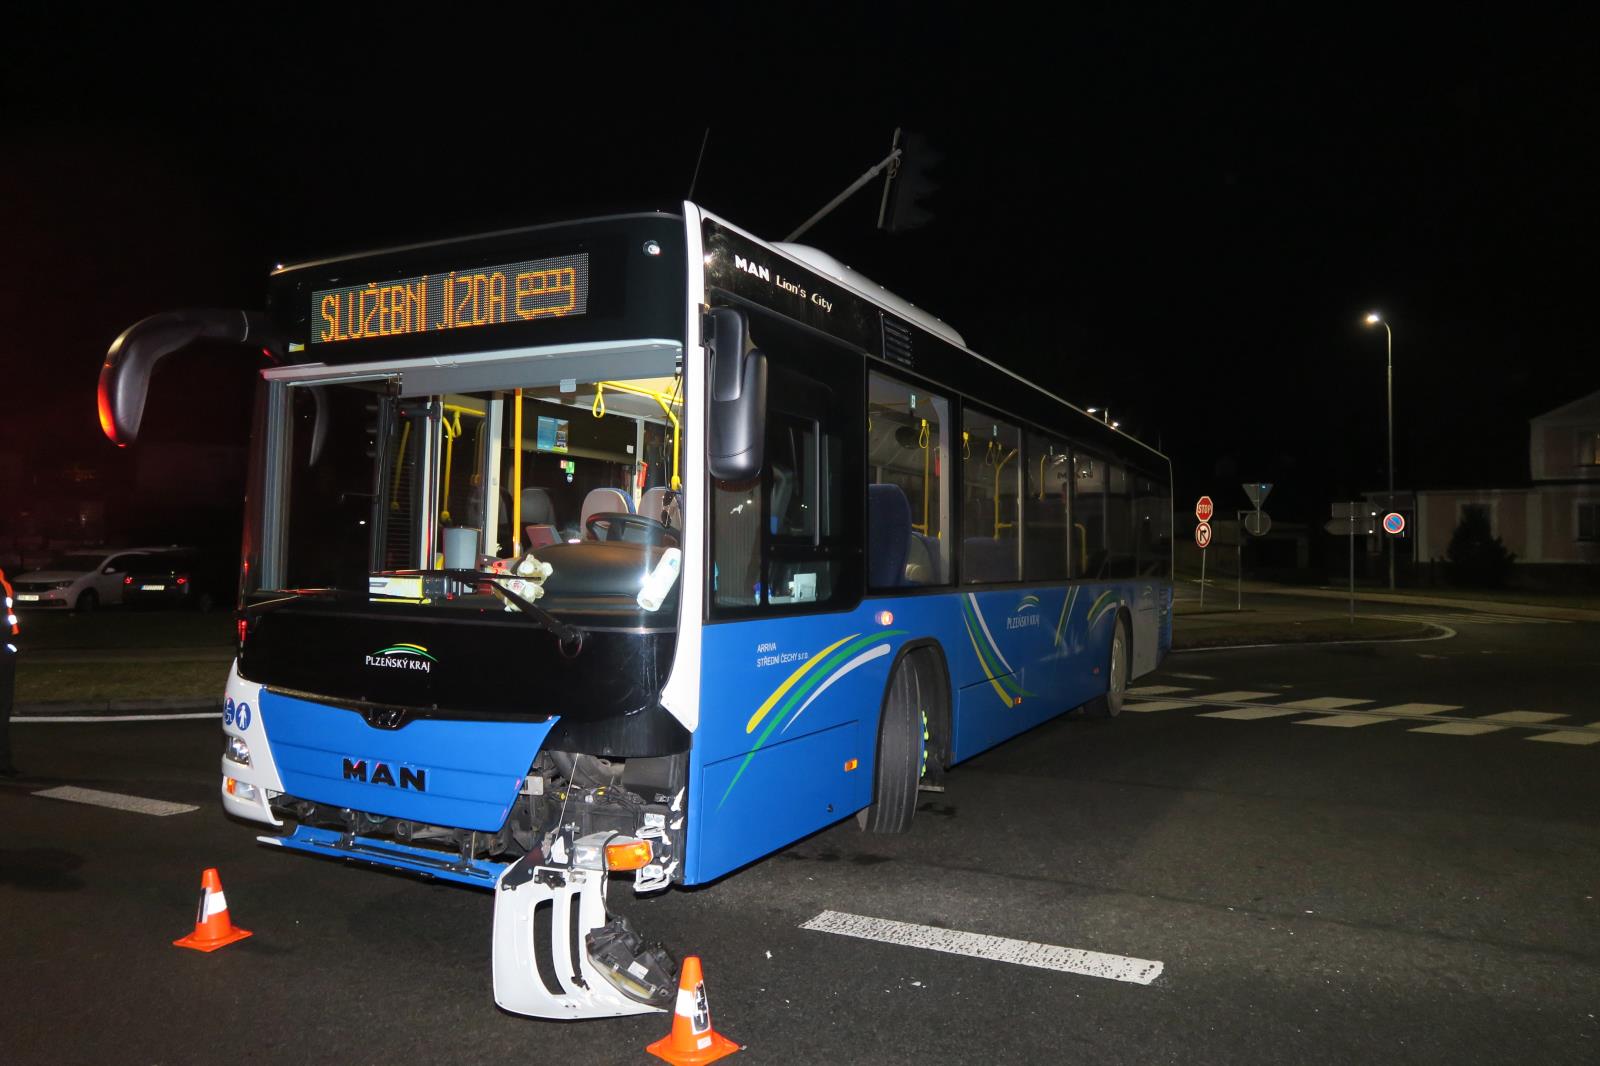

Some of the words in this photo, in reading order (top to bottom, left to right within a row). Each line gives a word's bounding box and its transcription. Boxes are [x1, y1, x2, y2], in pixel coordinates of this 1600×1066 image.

[735, 254, 770, 282] MAN
[776, 274, 807, 299] Lion's
[811, 293, 833, 313] City
[321, 275, 428, 342] SLUŽEBNÍ
[436, 271, 507, 330] JÍZDA
[1198, 504, 1211, 515] STOP
[756, 642, 776, 653] ARRIVA
[365, 655, 408, 669] PLZEŇSKÝ
[409, 659, 431, 673] KRAJ
[342, 757, 425, 792] MAN
